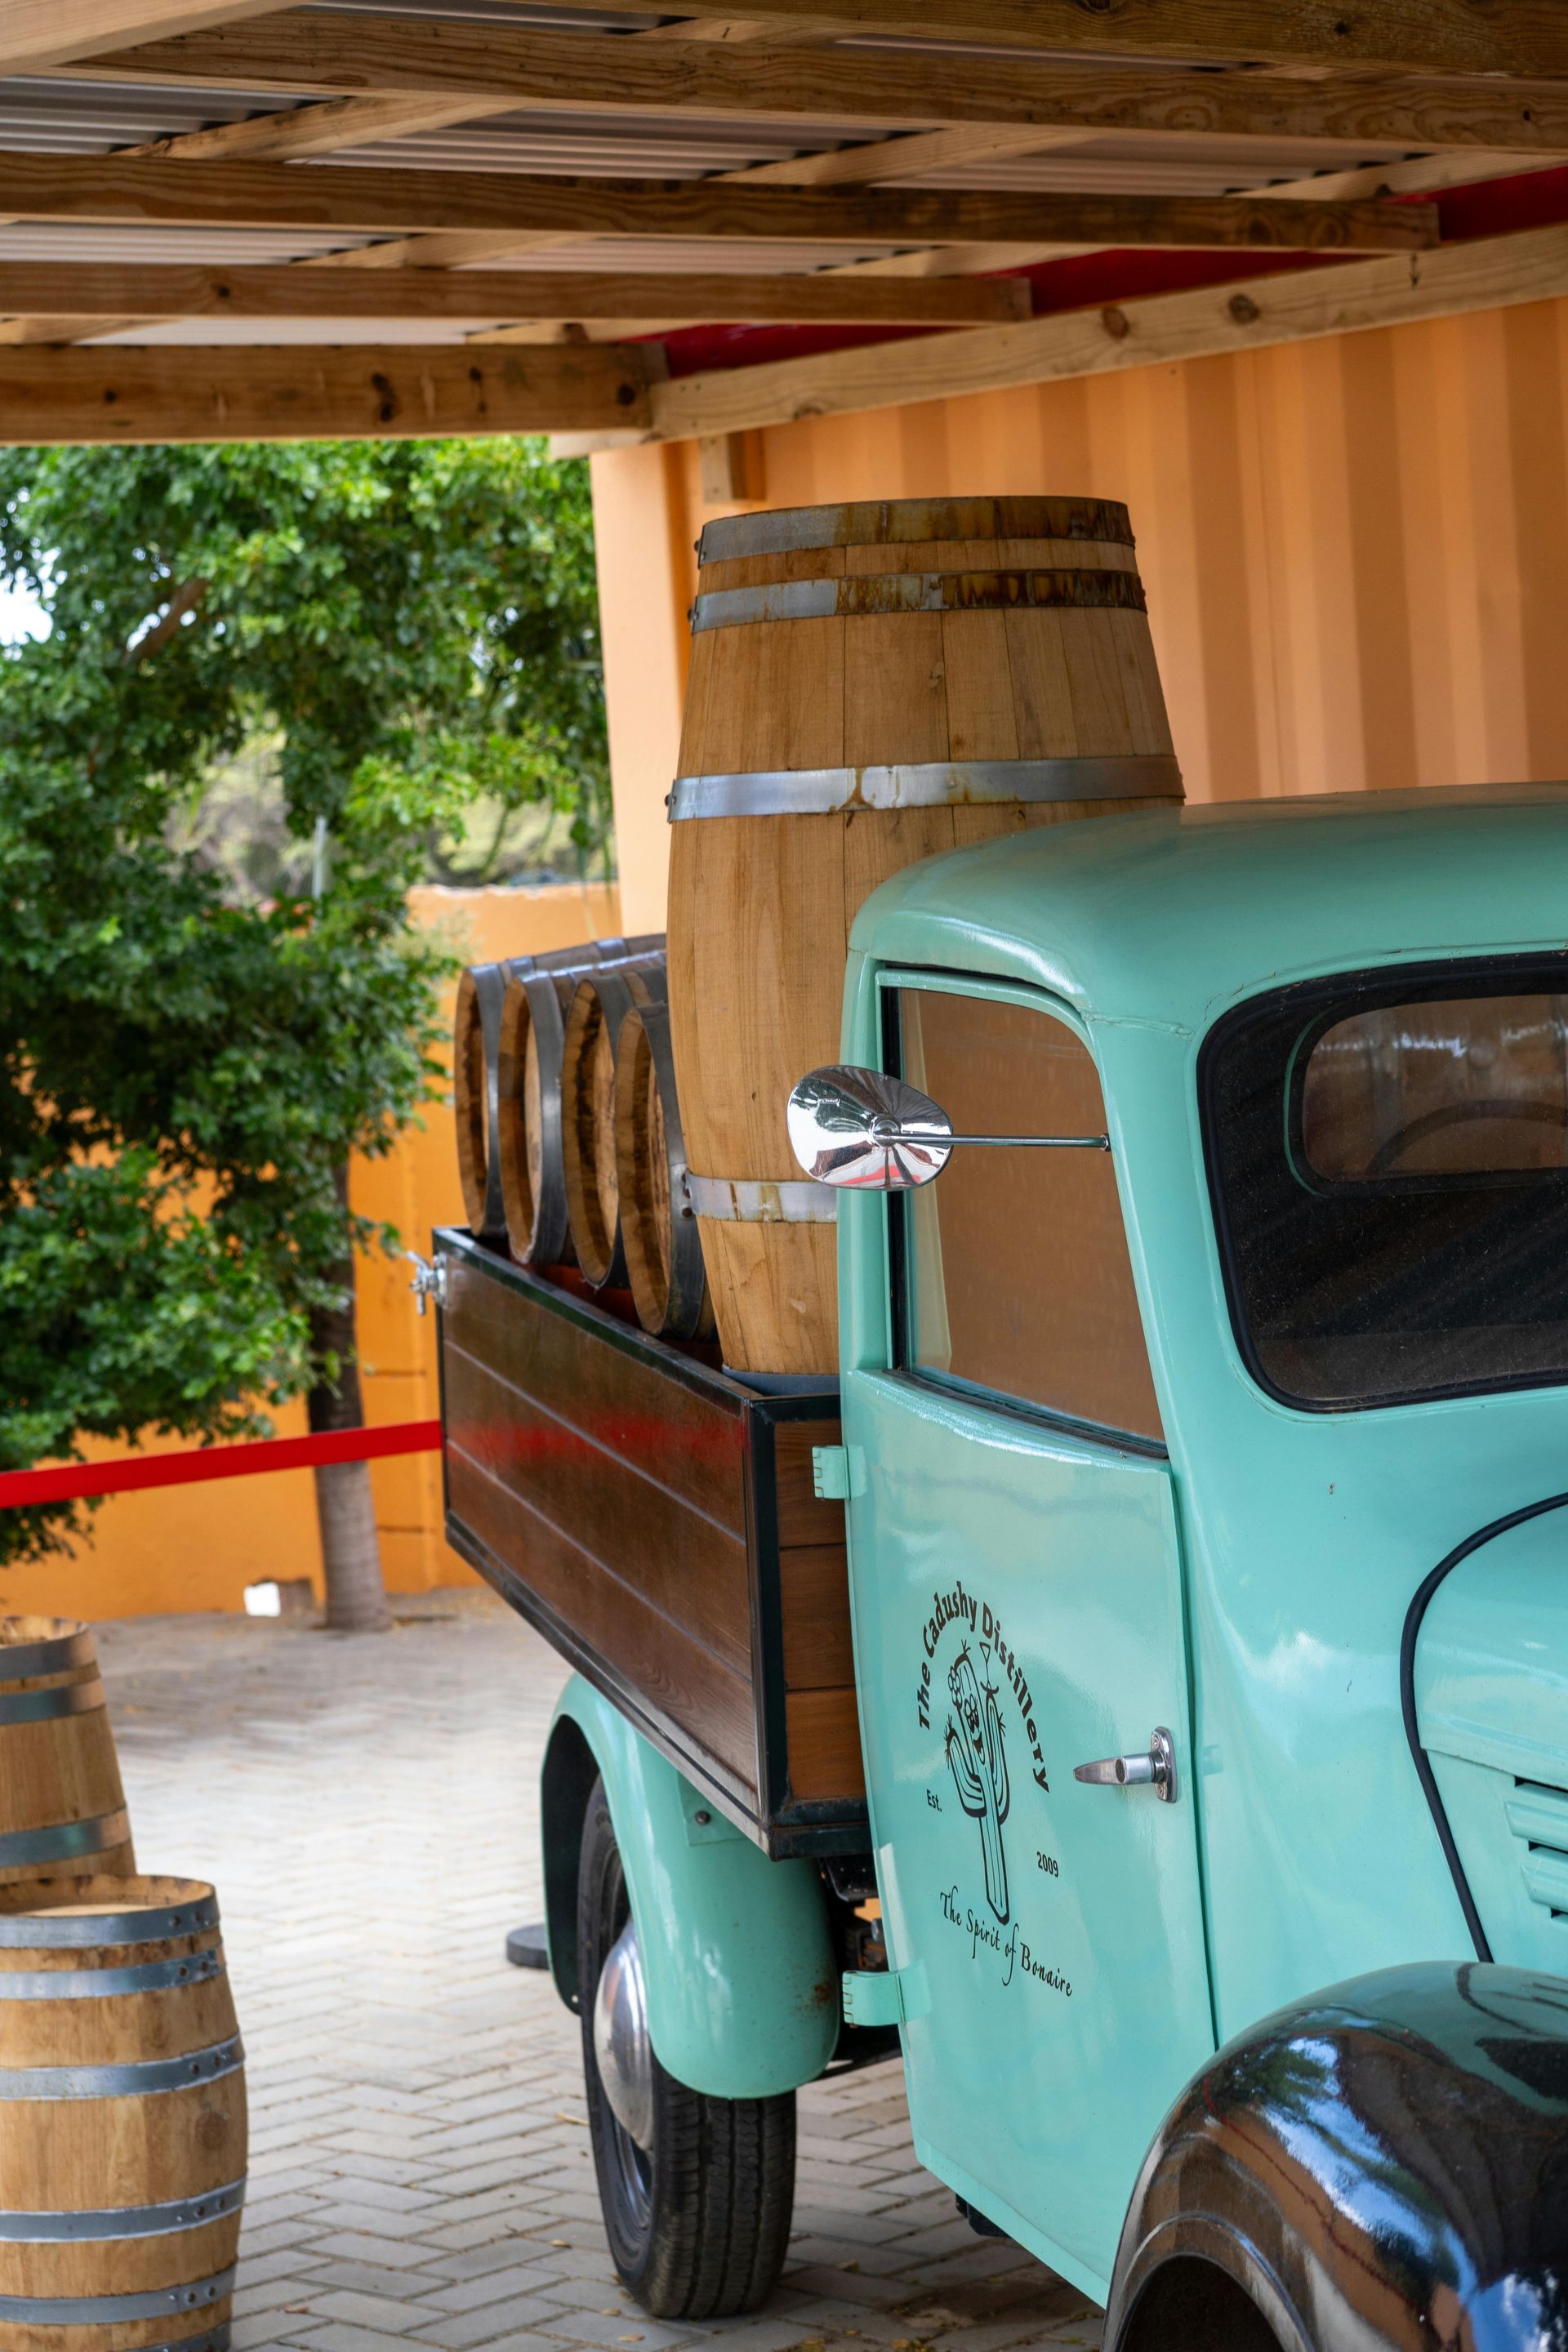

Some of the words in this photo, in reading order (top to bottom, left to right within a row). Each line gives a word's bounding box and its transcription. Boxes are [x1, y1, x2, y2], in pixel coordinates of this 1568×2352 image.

[923, 1580, 978, 1659] Cadushy
[916, 1661, 931, 1731] The
[982, 1601, 1050, 1793] Distillery
[926, 1788, 942, 1813] Est.
[1036, 1851, 1059, 1878] 2009
[940, 1885, 962, 1926] The
[966, 1909, 1000, 1959] Spirit
[1001, 1922, 1019, 1986] of
[1020, 1941, 1073, 1997] Bonaire
